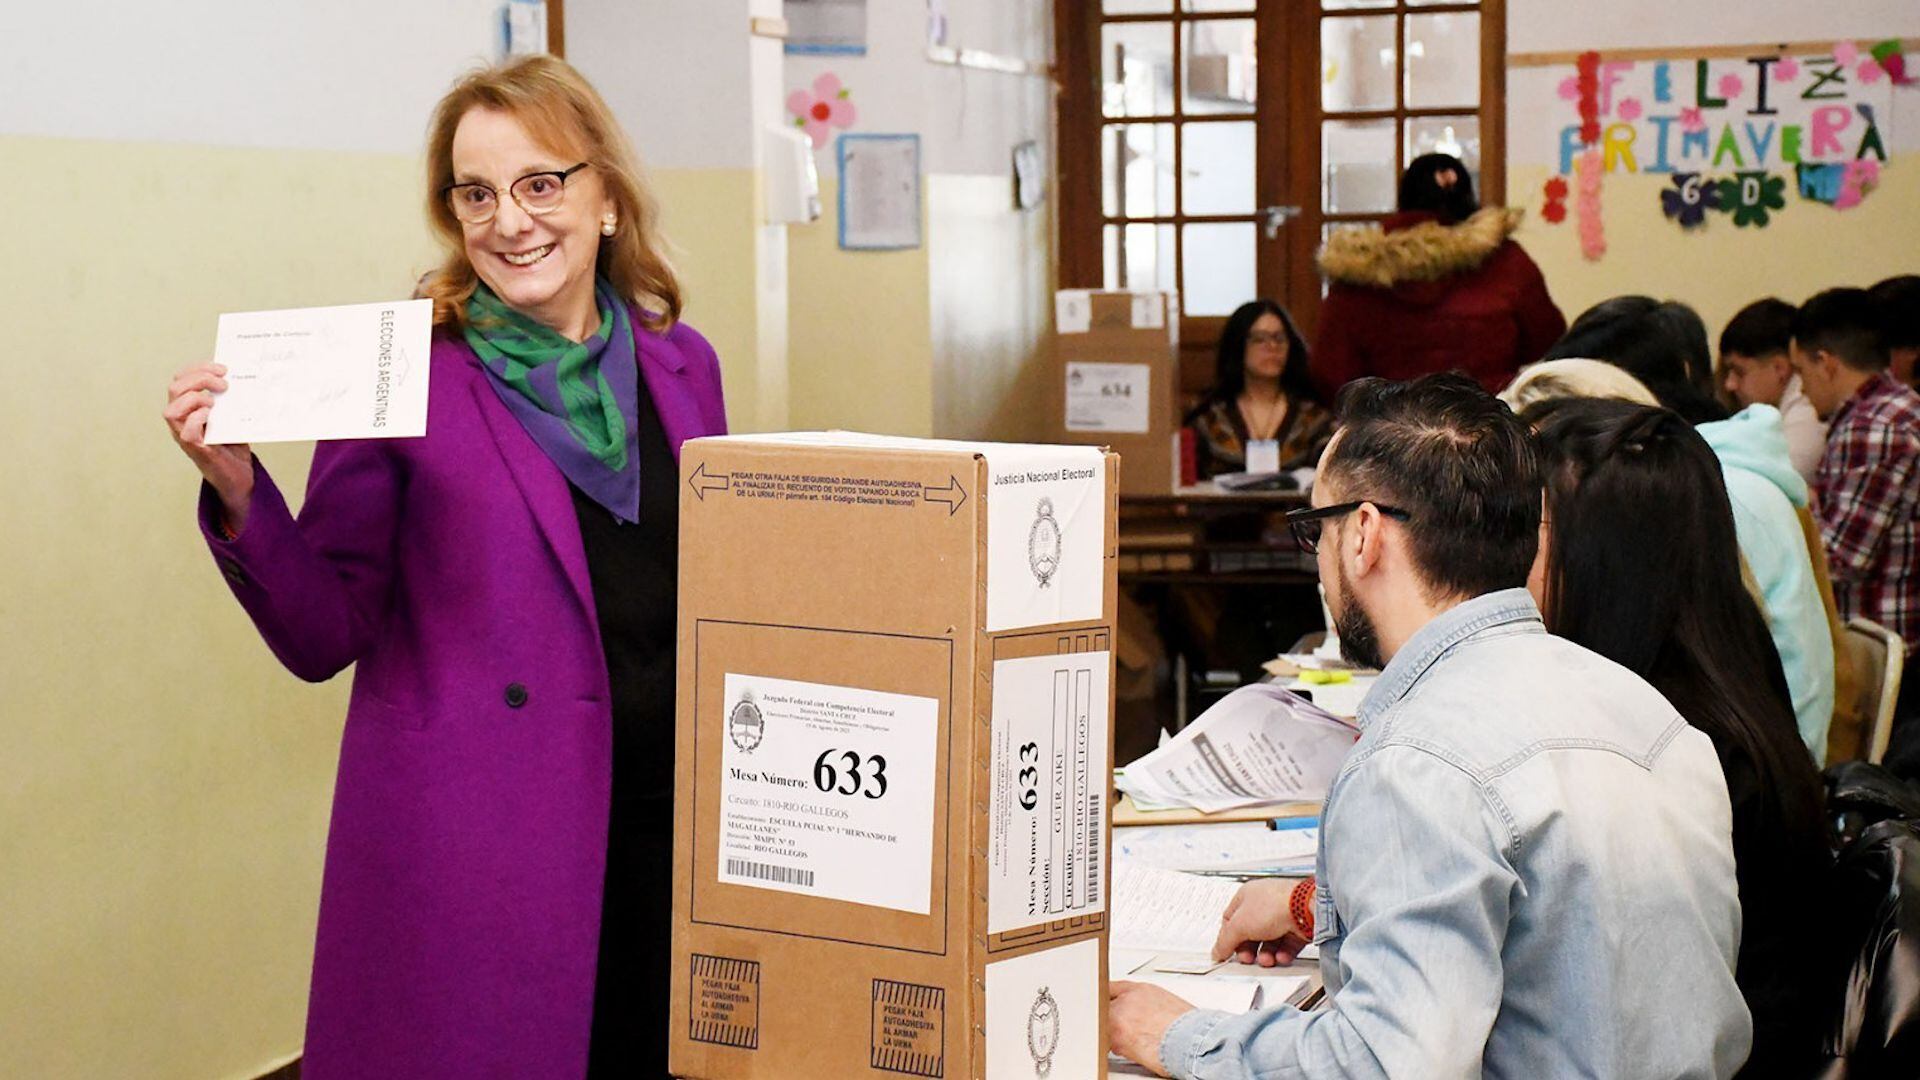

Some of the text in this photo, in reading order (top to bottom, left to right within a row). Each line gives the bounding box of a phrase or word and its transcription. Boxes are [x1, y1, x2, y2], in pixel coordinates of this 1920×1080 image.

[1601, 56, 1847, 116] FELIZ
[373, 310, 394, 428] ELECCIONES ARGENTINAS
[731, 472, 753, 480] PEGAR
[754, 473, 773, 481] OTRA
[801, 476, 840, 484] SEGURIDAD
[842, 478, 870, 486] GRANDE
[871, 479, 921, 488] AUTOADHESIVA
[994, 468, 1095, 485] Justicia Nacional Electoral
[743, 481, 776, 489] FINALIZAR
[786, 484, 822, 492] RECUENTO
[834, 486, 856, 494] VOTOS
[858, 487, 888, 495] TAPANDO
[833, 495, 855, 504] Código
[857, 496, 884, 504] Electoral
[790, 696, 813, 706] Federal
[826, 701, 866, 713] Competencia
[867, 706, 895, 717] Electoral
[730, 748, 888, 799] Mesa Número: 633
[1054, 748, 1063, 833] GUER AIKE
[1076, 715, 1086, 861] 1810-RIO GALLEGOS
[763, 800, 799, 811] 1810-RIO
[801, 804, 849, 819] GALLEGOS
[769, 816, 802, 828] ESCUELA
[804, 822, 824, 831] PCIAL
[1018, 741, 1039, 916] Mesa Número: 633
[754, 844, 768, 852] RIO
[769, 846, 809, 858] GALLEGOS
[1042, 859, 1050, 914] Sección:
[1065, 849, 1073, 909] Circuito:
[702, 979, 740, 991] PEGAR FAJA
[702, 990, 750, 1003] AUTOADHESIVA
[702, 1000, 734, 1011] AL ARMAR
[884, 1005, 924, 1018] PEGAR FAJA
[711, 1012, 728, 1021] URNA
[884, 1016, 935, 1030] AUTOADHESIVA
[884, 1027, 918, 1040] AL ARMAR
[883, 1037, 913, 1049] LA URNA
